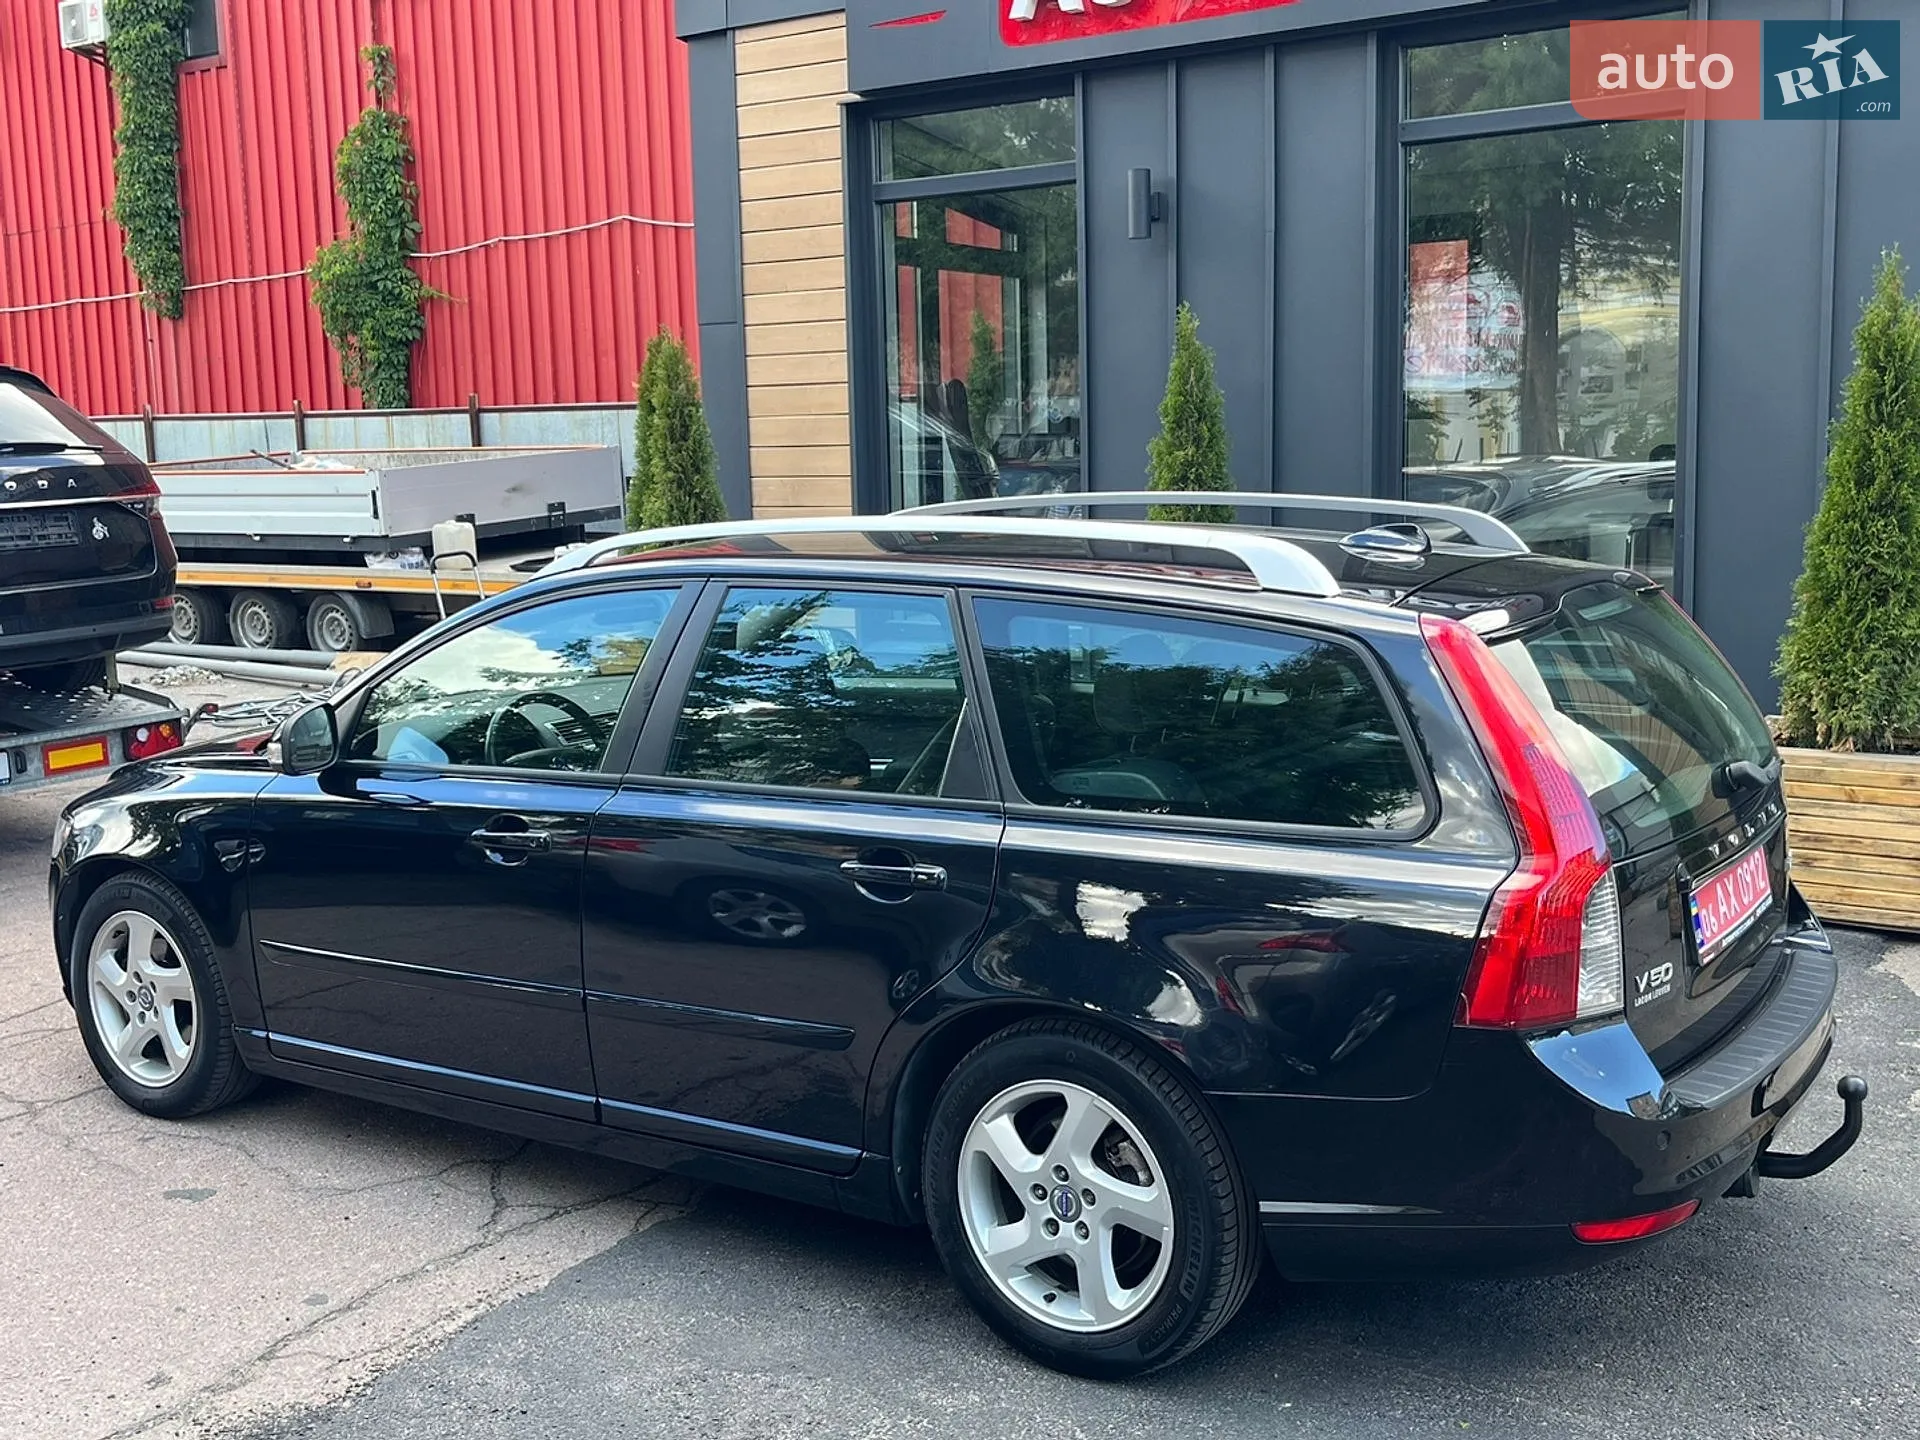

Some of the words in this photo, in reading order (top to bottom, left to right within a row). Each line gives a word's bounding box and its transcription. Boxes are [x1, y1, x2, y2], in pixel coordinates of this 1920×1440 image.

[1708, 803, 1778, 859] VOLVO
[1701, 903, 1719, 939] 06
[1716, 873, 1741, 926] AX
[1634, 962, 1673, 993] V50
